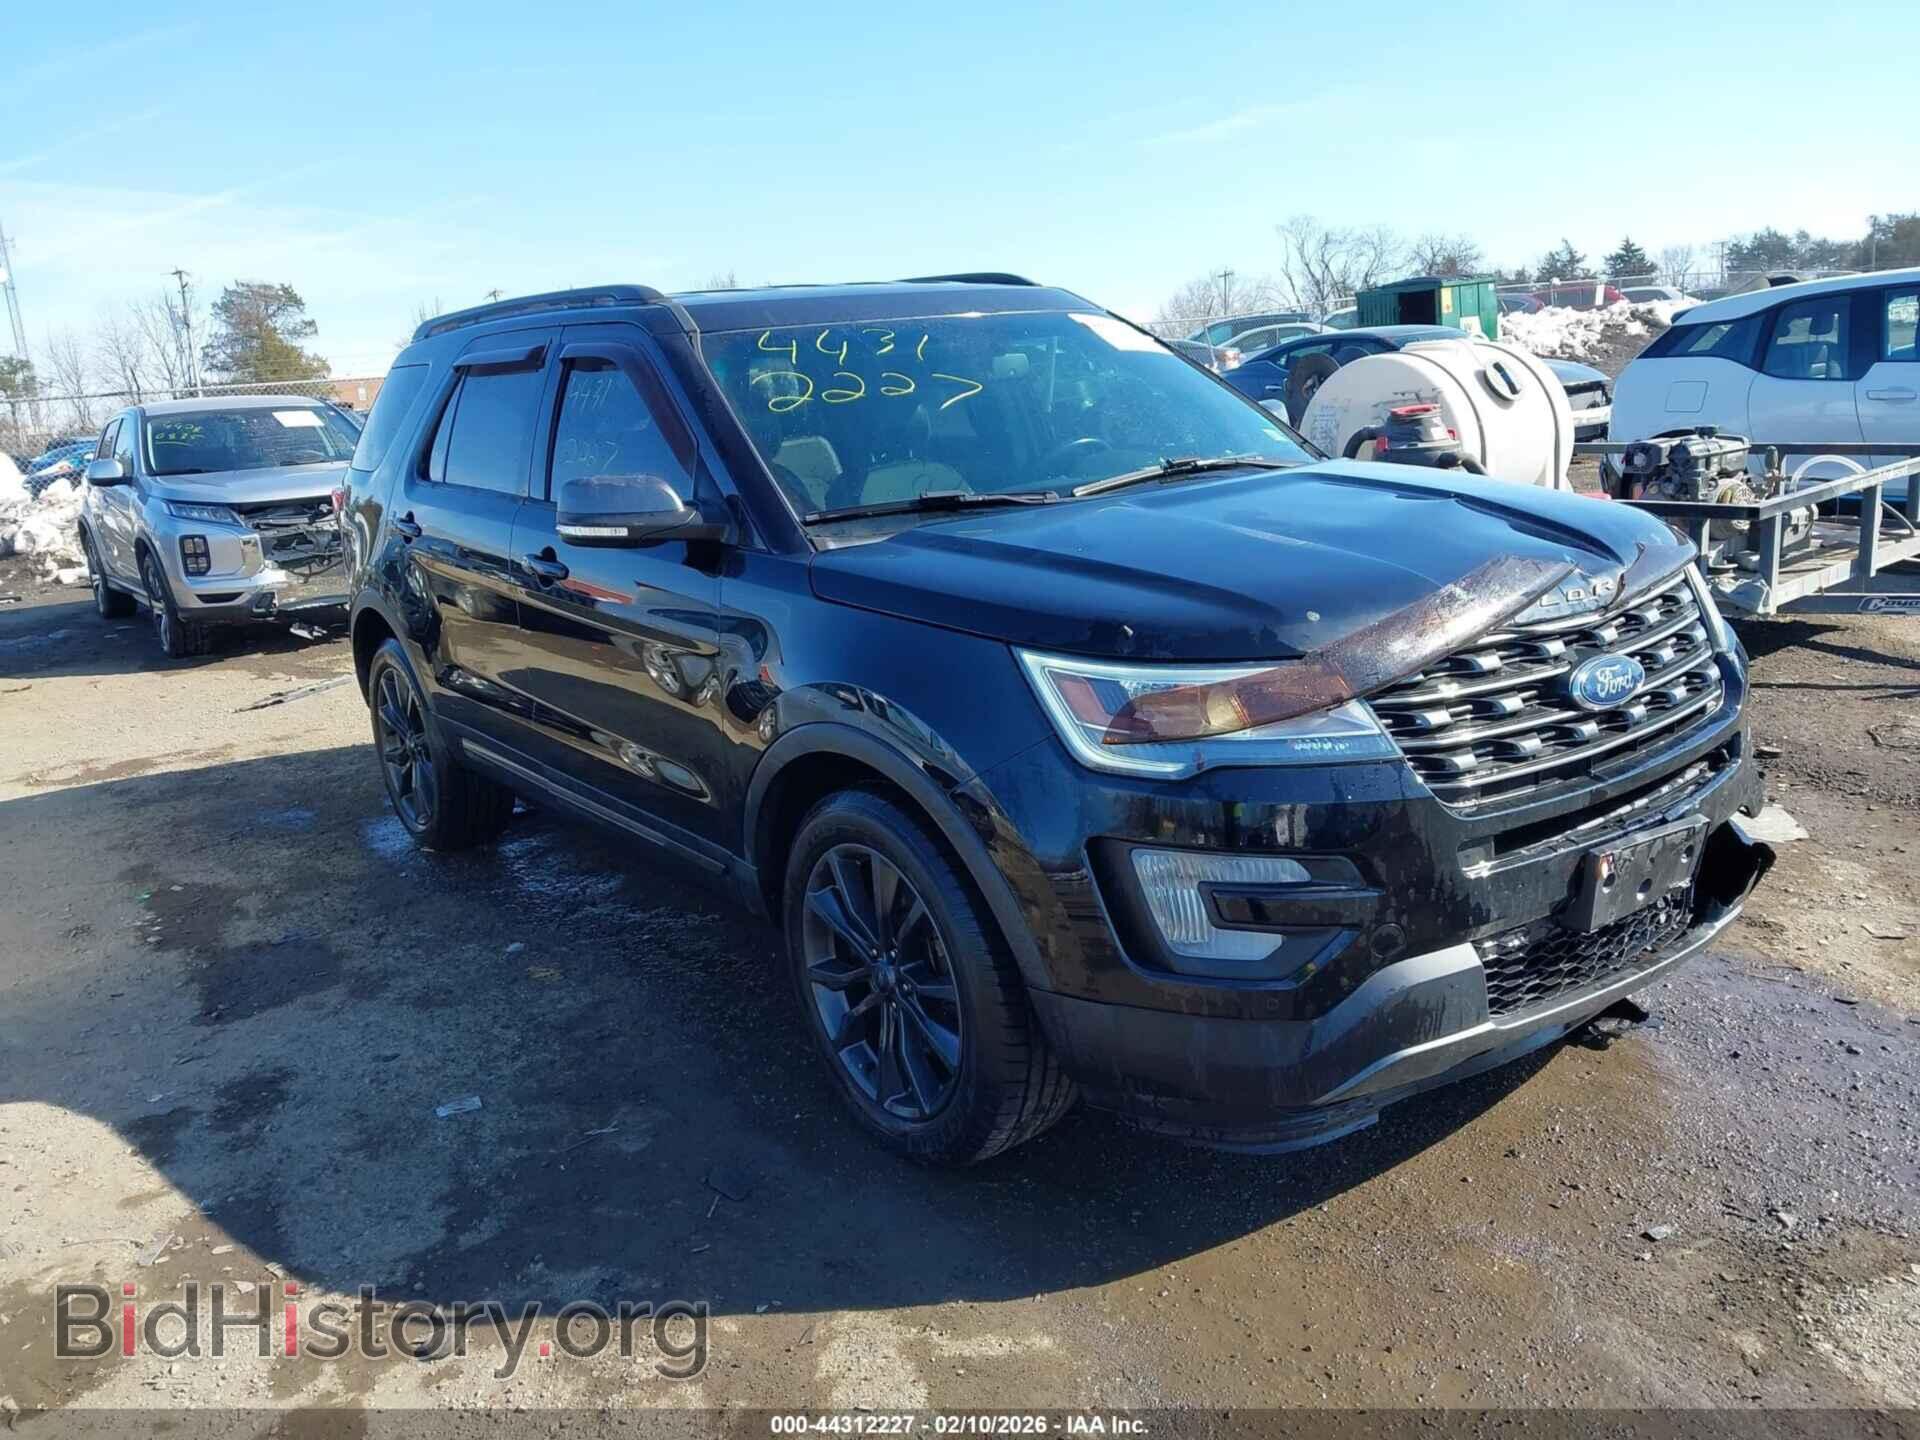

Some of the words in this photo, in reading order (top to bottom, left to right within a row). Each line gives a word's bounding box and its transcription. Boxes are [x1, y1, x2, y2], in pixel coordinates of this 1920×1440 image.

[757, 328, 930, 366] 4431
[751, 372, 984, 413] 2227
[1595, 664, 1634, 699] Ford
